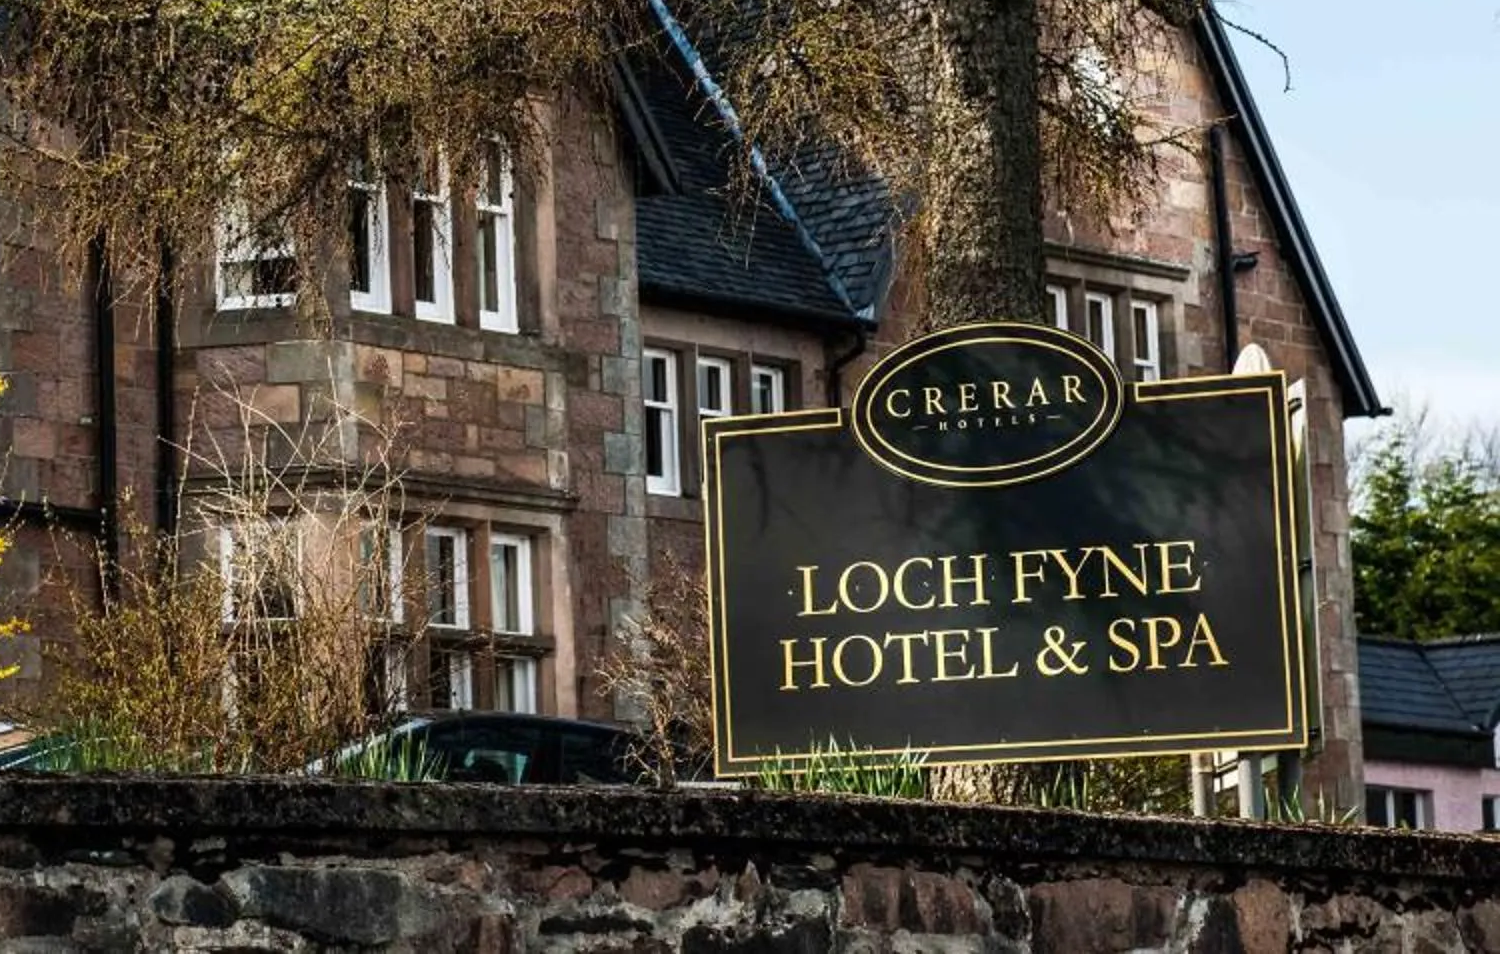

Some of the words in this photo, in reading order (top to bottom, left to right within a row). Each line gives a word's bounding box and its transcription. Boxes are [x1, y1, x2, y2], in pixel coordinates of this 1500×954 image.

[885, 373, 1087, 419] CRERAR
[937, 413, 1038, 431] HOTELS
[795, 553, 991, 617] LOCH
[1010, 540, 1202, 605] FYNE
[779, 627, 1019, 691] HOTEL
[1035, 624, 1089, 676] &
[1107, 613, 1229, 673] SPA
